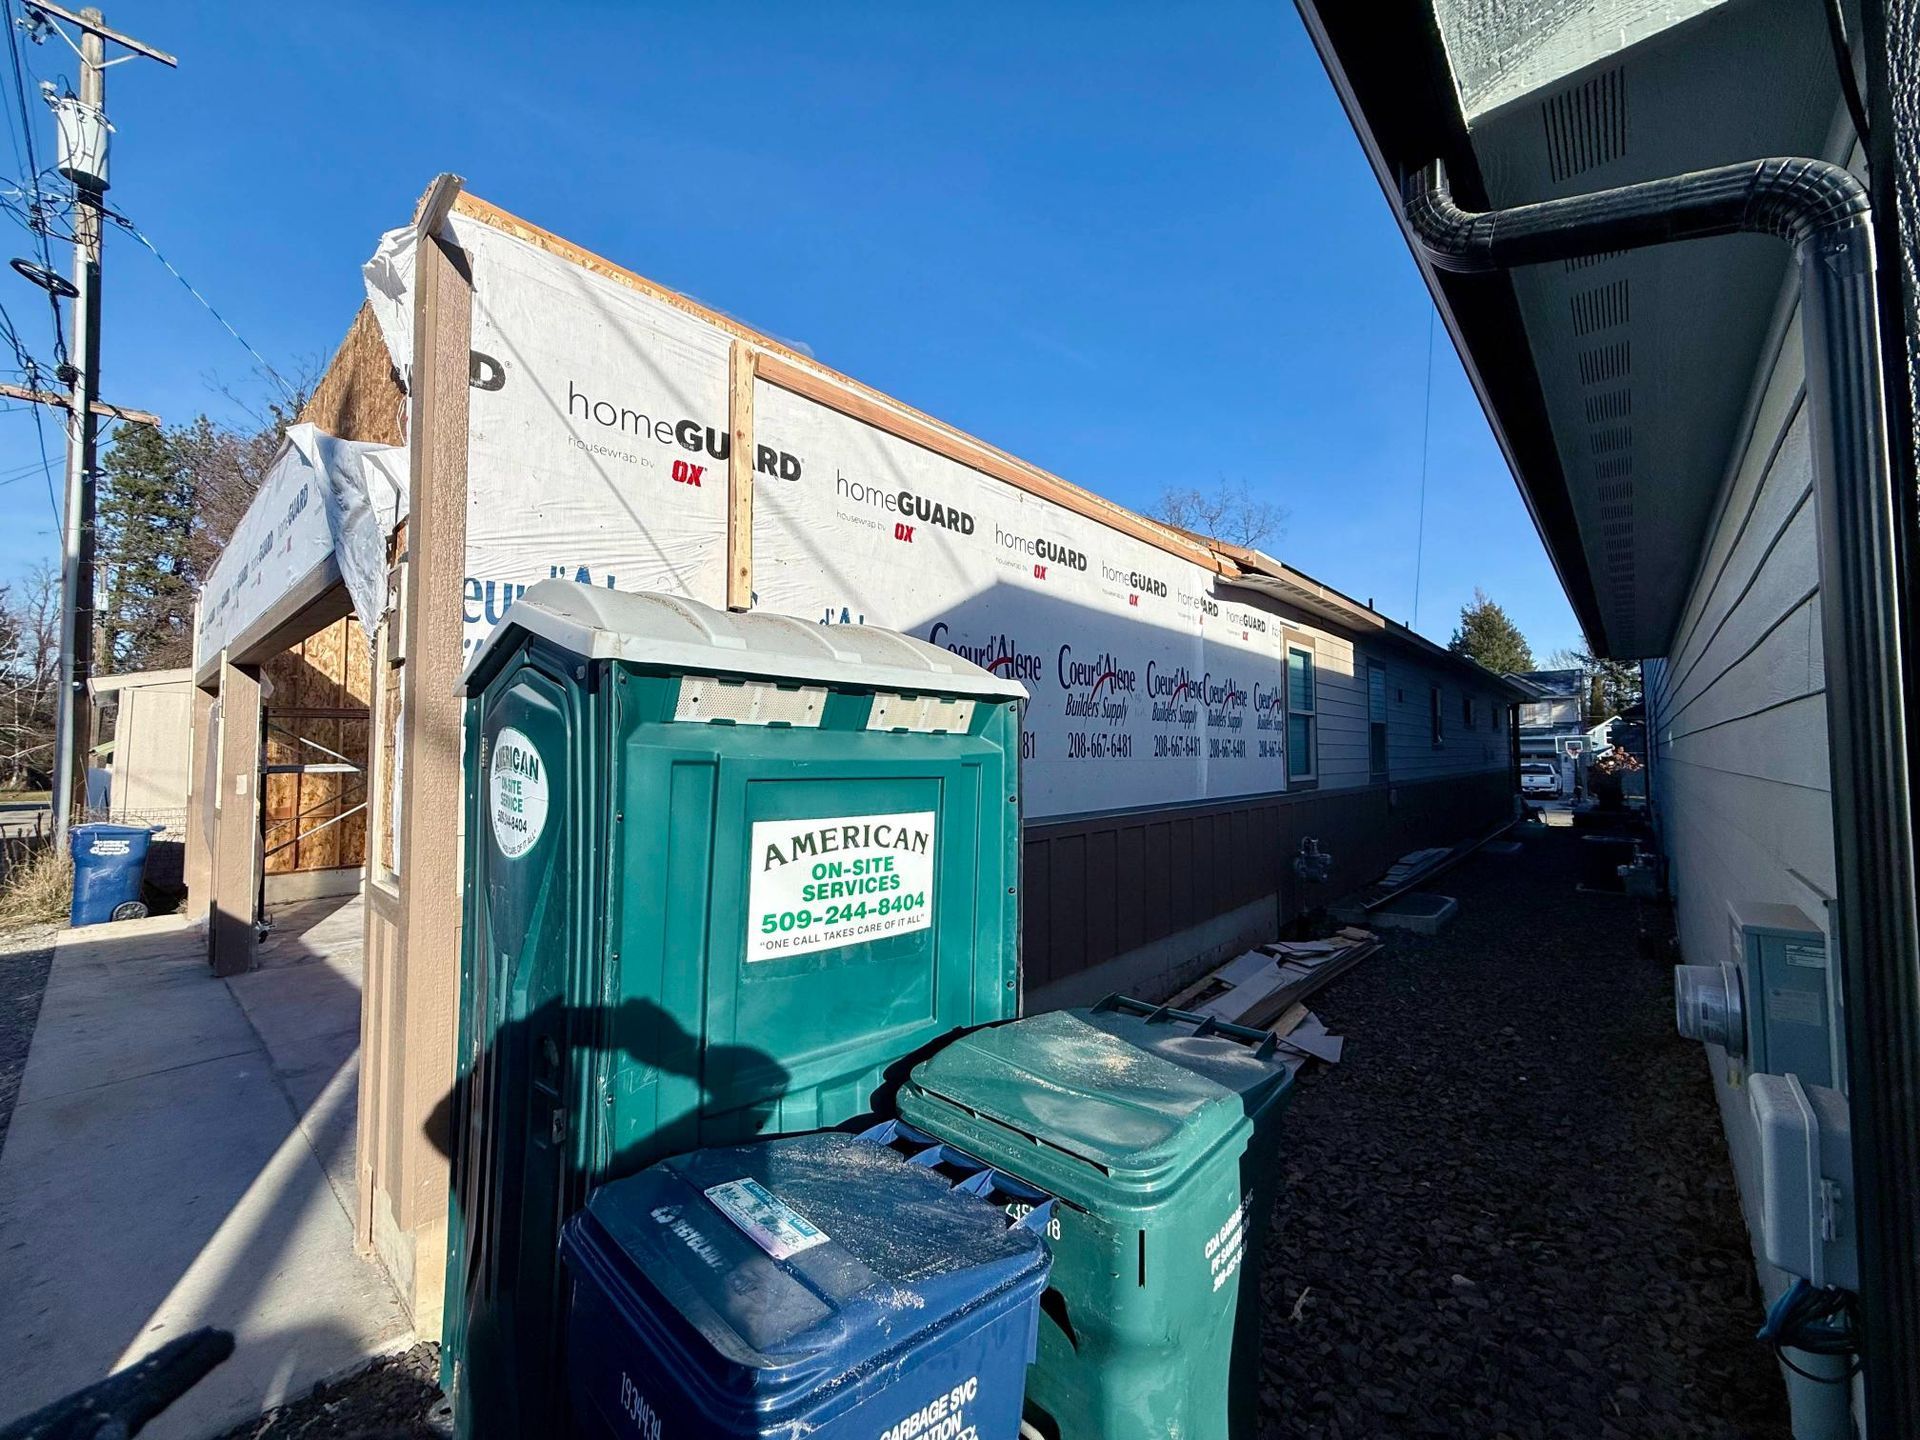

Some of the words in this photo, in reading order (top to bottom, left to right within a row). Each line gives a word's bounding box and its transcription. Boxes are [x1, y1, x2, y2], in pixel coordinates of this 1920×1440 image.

[568, 380, 802, 483] homeGURD
[671, 459, 704, 488] OX
[836, 468, 975, 536] homeGUARD
[894, 522, 914, 544] OX
[995, 522, 1088, 573] homeGUARD
[1033, 563, 1047, 581] OX
[1102, 560, 1168, 598] homeGUARD
[1065, 691, 1100, 720] Builders
[1101, 696, 1130, 727] Supply
[1151, 701, 1178, 724] Builders
[1178, 704, 1198, 730] Supply
[1067, 732, 1132, 759] 208-667-6481
[763, 824, 930, 872] AMERICAN
[811, 855, 895, 881] ON-SITE
[802, 873, 901, 902] SERVICES
[761, 891, 925, 934] 509-244-8404
[792, 933, 821, 946] CALL
[823, 927, 855, 941] TAKES
[857, 922, 882, 935] CARE
[884, 919, 896, 930] OF
[897, 917, 906, 928] IT
[949, 1375, 978, 1412] SVC
